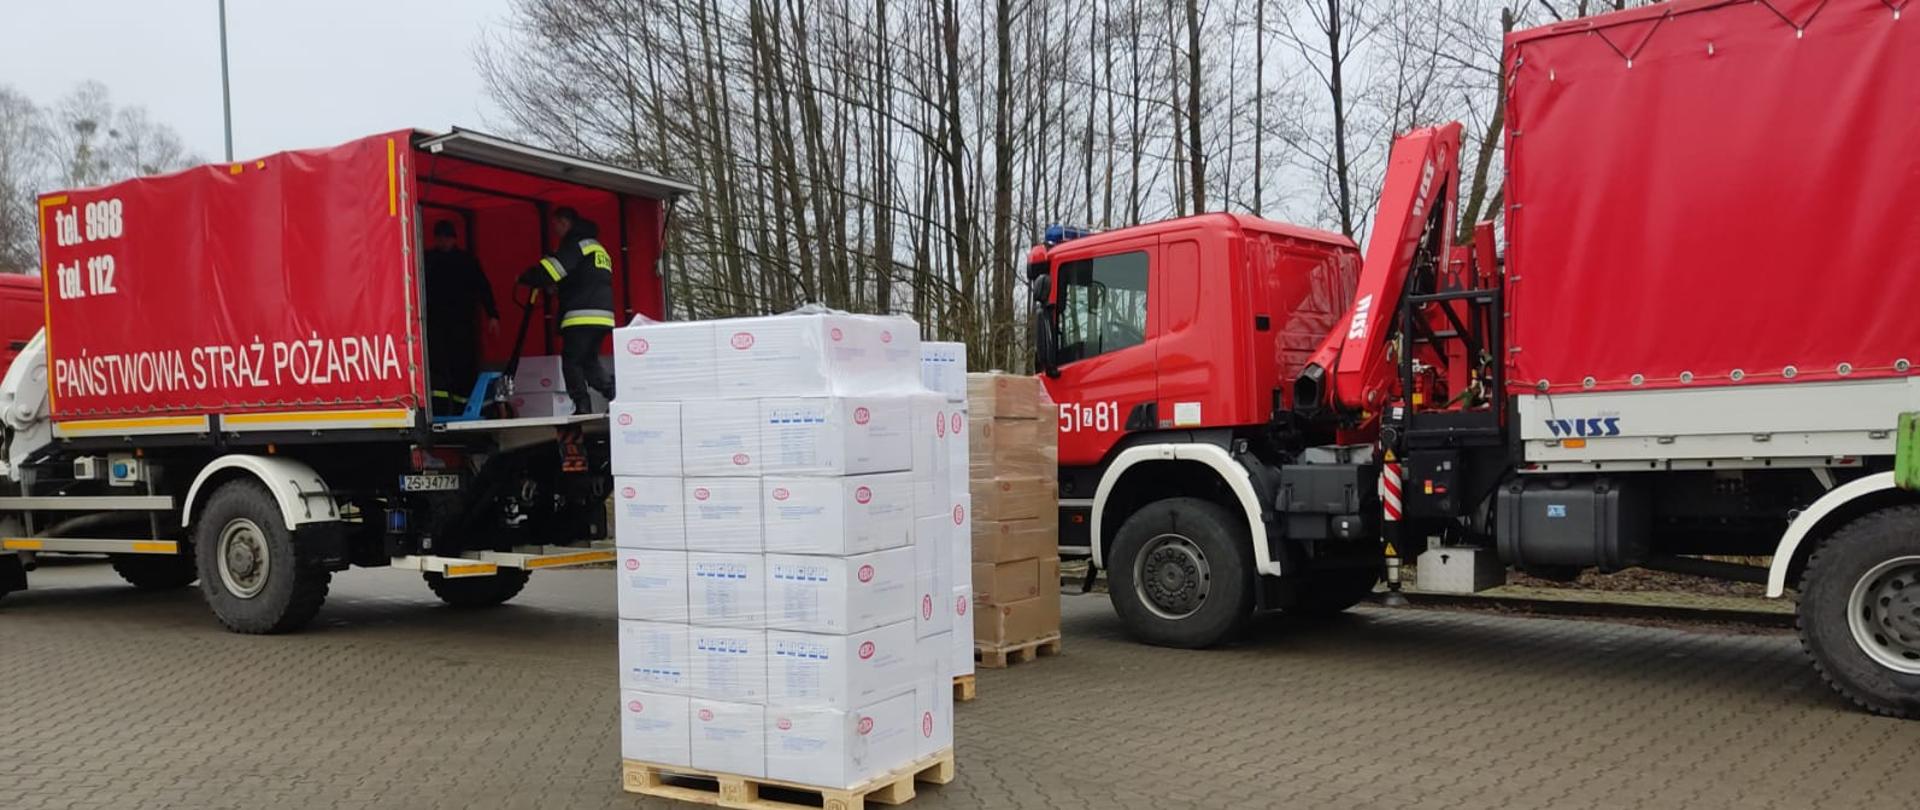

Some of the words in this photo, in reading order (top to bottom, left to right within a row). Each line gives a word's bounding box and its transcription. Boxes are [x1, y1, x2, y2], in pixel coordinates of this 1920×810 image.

[55, 209, 83, 247] tel.
[85, 198, 123, 241] 998
[57, 259, 86, 299] tel.
[87, 254, 117, 295] 112
[55, 348, 189, 398] PAŃSTWOWA
[191, 335, 269, 389] STRAŻ
[273, 330, 402, 385] POŻARNA
[1059, 402, 1081, 433] 51
[1095, 401, 1119, 432] 81
[1544, 418, 1621, 437] WISS
